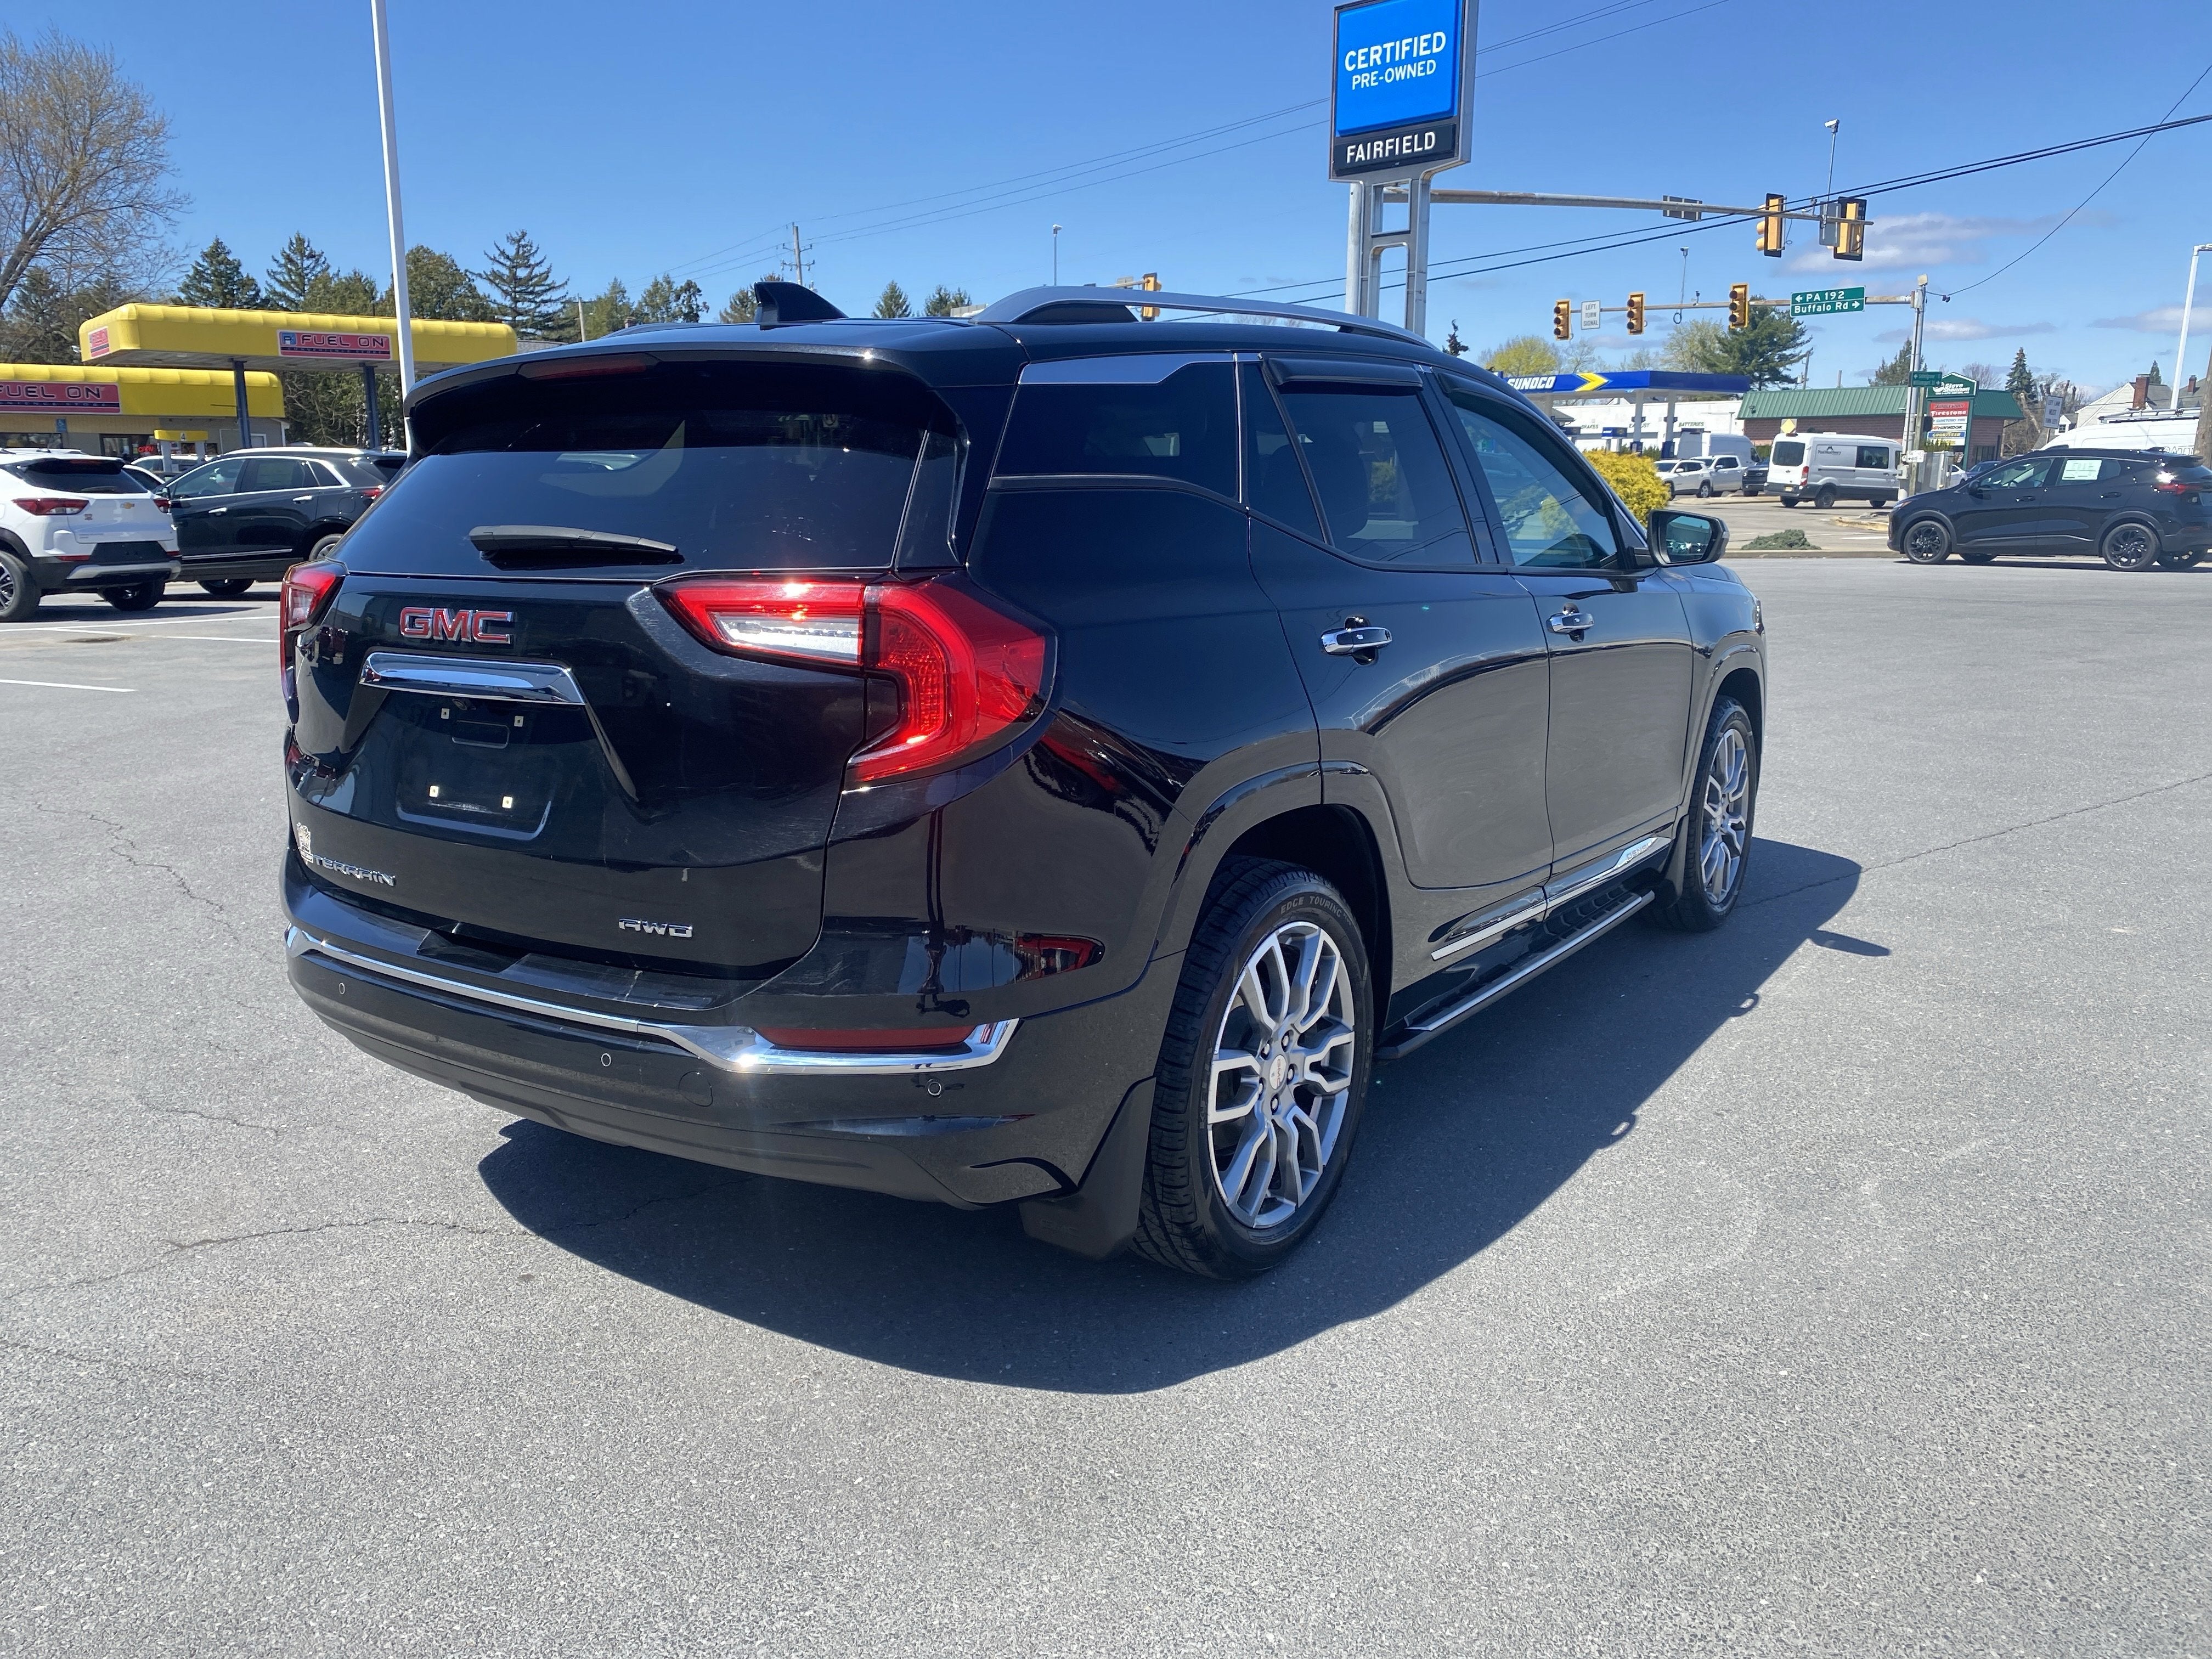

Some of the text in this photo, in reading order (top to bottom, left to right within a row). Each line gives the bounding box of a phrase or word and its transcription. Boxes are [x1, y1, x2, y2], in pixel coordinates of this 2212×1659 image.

[1345, 31, 1446, 71] CERTIFIED
[1352, 59, 1436, 91] PRE-OWNED
[1346, 132, 1436, 163] FAIRFIELD
[1794, 302, 1848, 313] Buffalo Rd
[1806, 291, 1844, 302] PA 192
[301, 334, 385, 348] FUEL ON
[66, 385, 101, 400] ON
[1507, 376, 1556, 390] SUNOCO
[399, 606, 515, 645] GMC
[313, 854, 396, 887] TERRAIN
[1280, 896, 1305, 915] EDGE
[1310, 895, 1342, 918] TOURING
[618, 917, 692, 938] AWD
